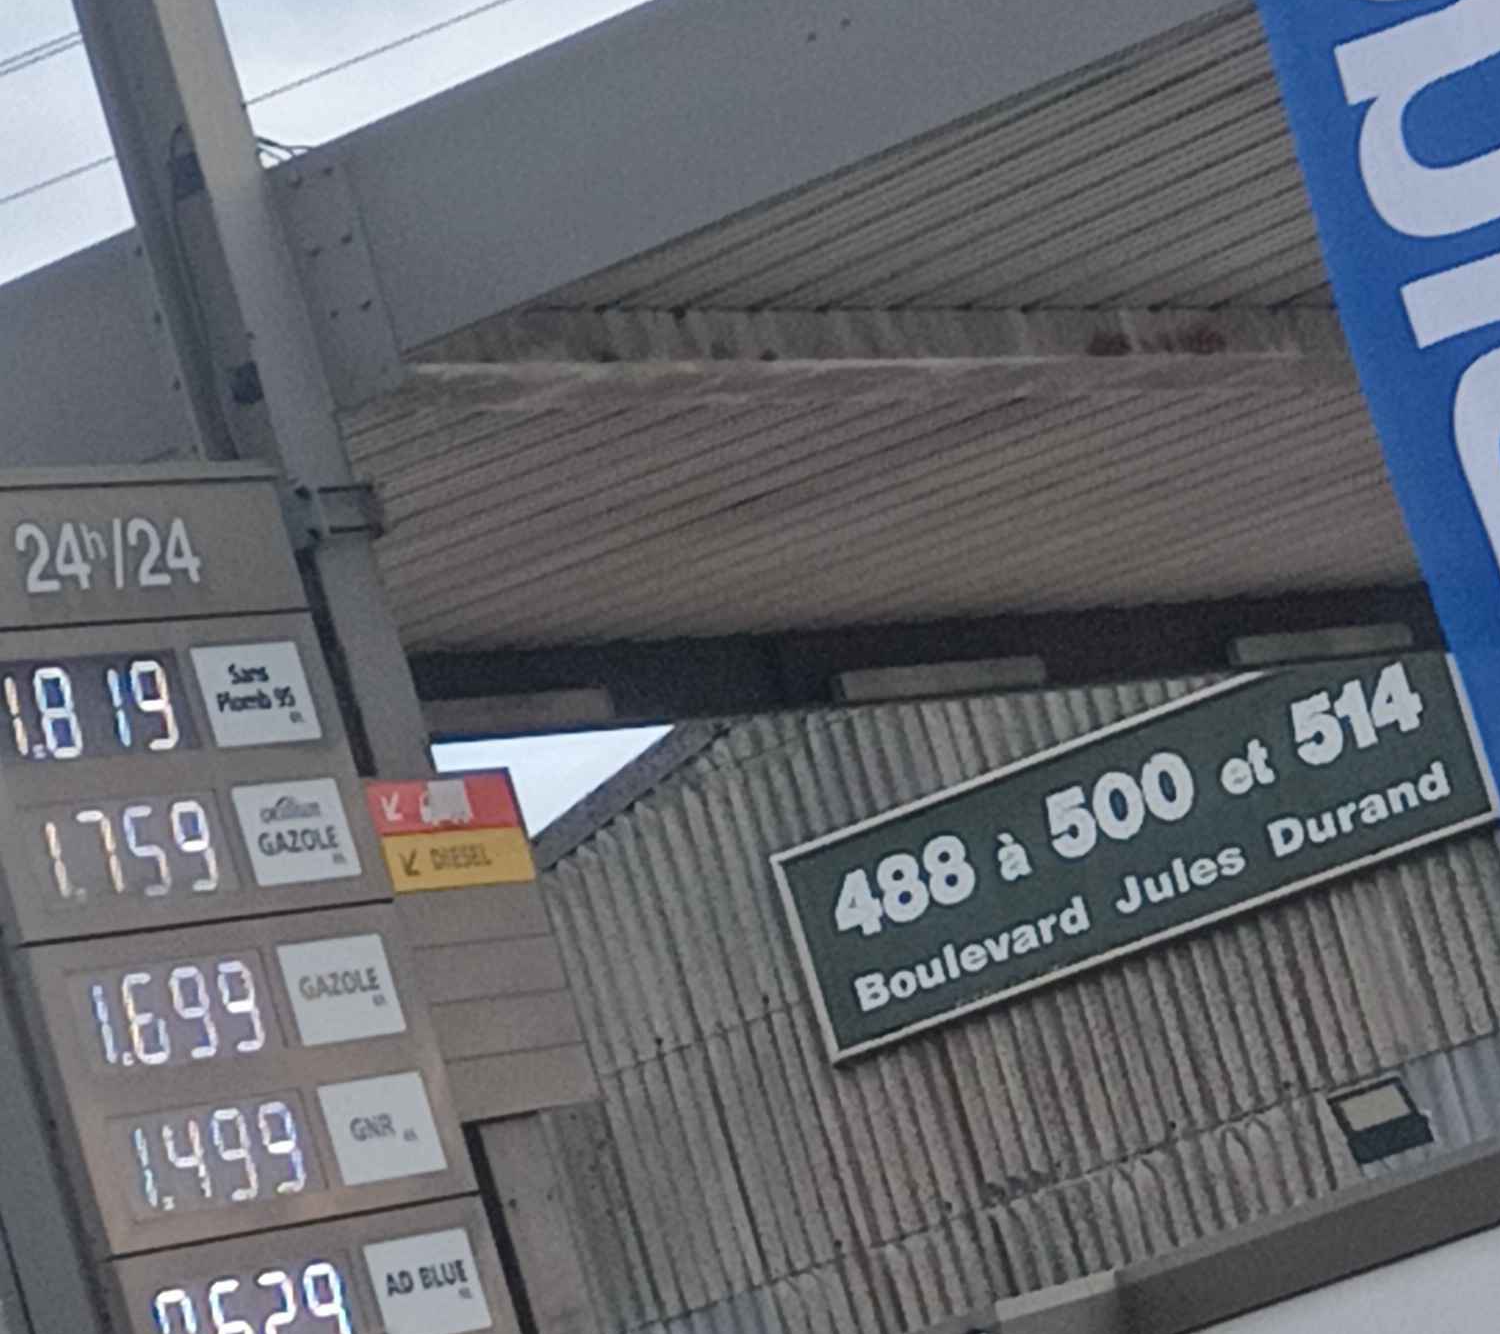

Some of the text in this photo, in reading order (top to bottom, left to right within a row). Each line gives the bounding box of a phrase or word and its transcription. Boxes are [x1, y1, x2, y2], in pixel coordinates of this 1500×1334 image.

[833, 661, 1424, 936] 488 à 500 et 514
[257, 824, 340, 856] GAZOLE
[853, 762, 1450, 1012] Boulevard Jules Durand
[298, 966, 381, 1001] GAZOLE
[349, 1112, 397, 1142] GNR
[386, 1259, 468, 1297] AD BLUE
